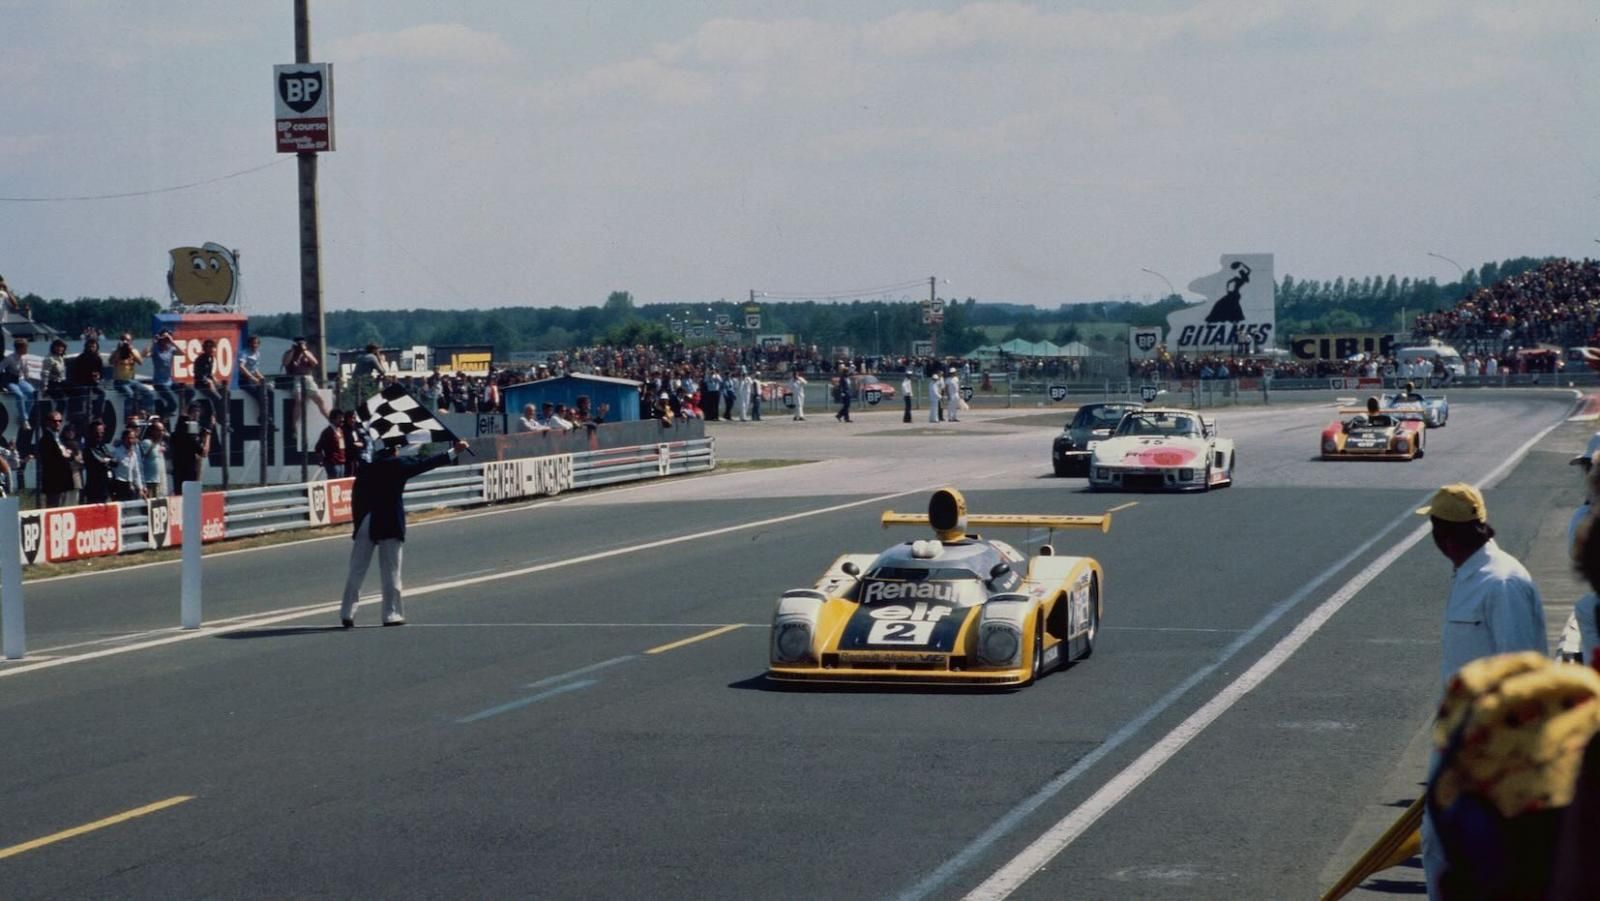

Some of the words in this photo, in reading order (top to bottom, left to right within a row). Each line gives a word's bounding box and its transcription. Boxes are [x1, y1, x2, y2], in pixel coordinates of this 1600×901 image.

[286, 78, 319, 102] BP
[278, 122, 291, 131] BP
[293, 123, 327, 131] course
[1139, 336, 1155, 347] BP
[173, 338, 232, 378] ESO
[867, 392, 881, 402] BP
[1052, 389, 1065, 398] BP
[1143, 389, 1156, 399] BP
[480, 416, 495, 434] elf
[314, 489, 325, 511] BP
[152, 505, 167, 535] BP
[202, 517, 223, 540] static
[24, 523, 40, 552] BP
[51, 512, 76, 559] BP
[76, 526, 116, 554] course
[864, 581, 960, 603] Renaul
[869, 602, 952, 621] elf
[883, 622, 917, 642] 2
